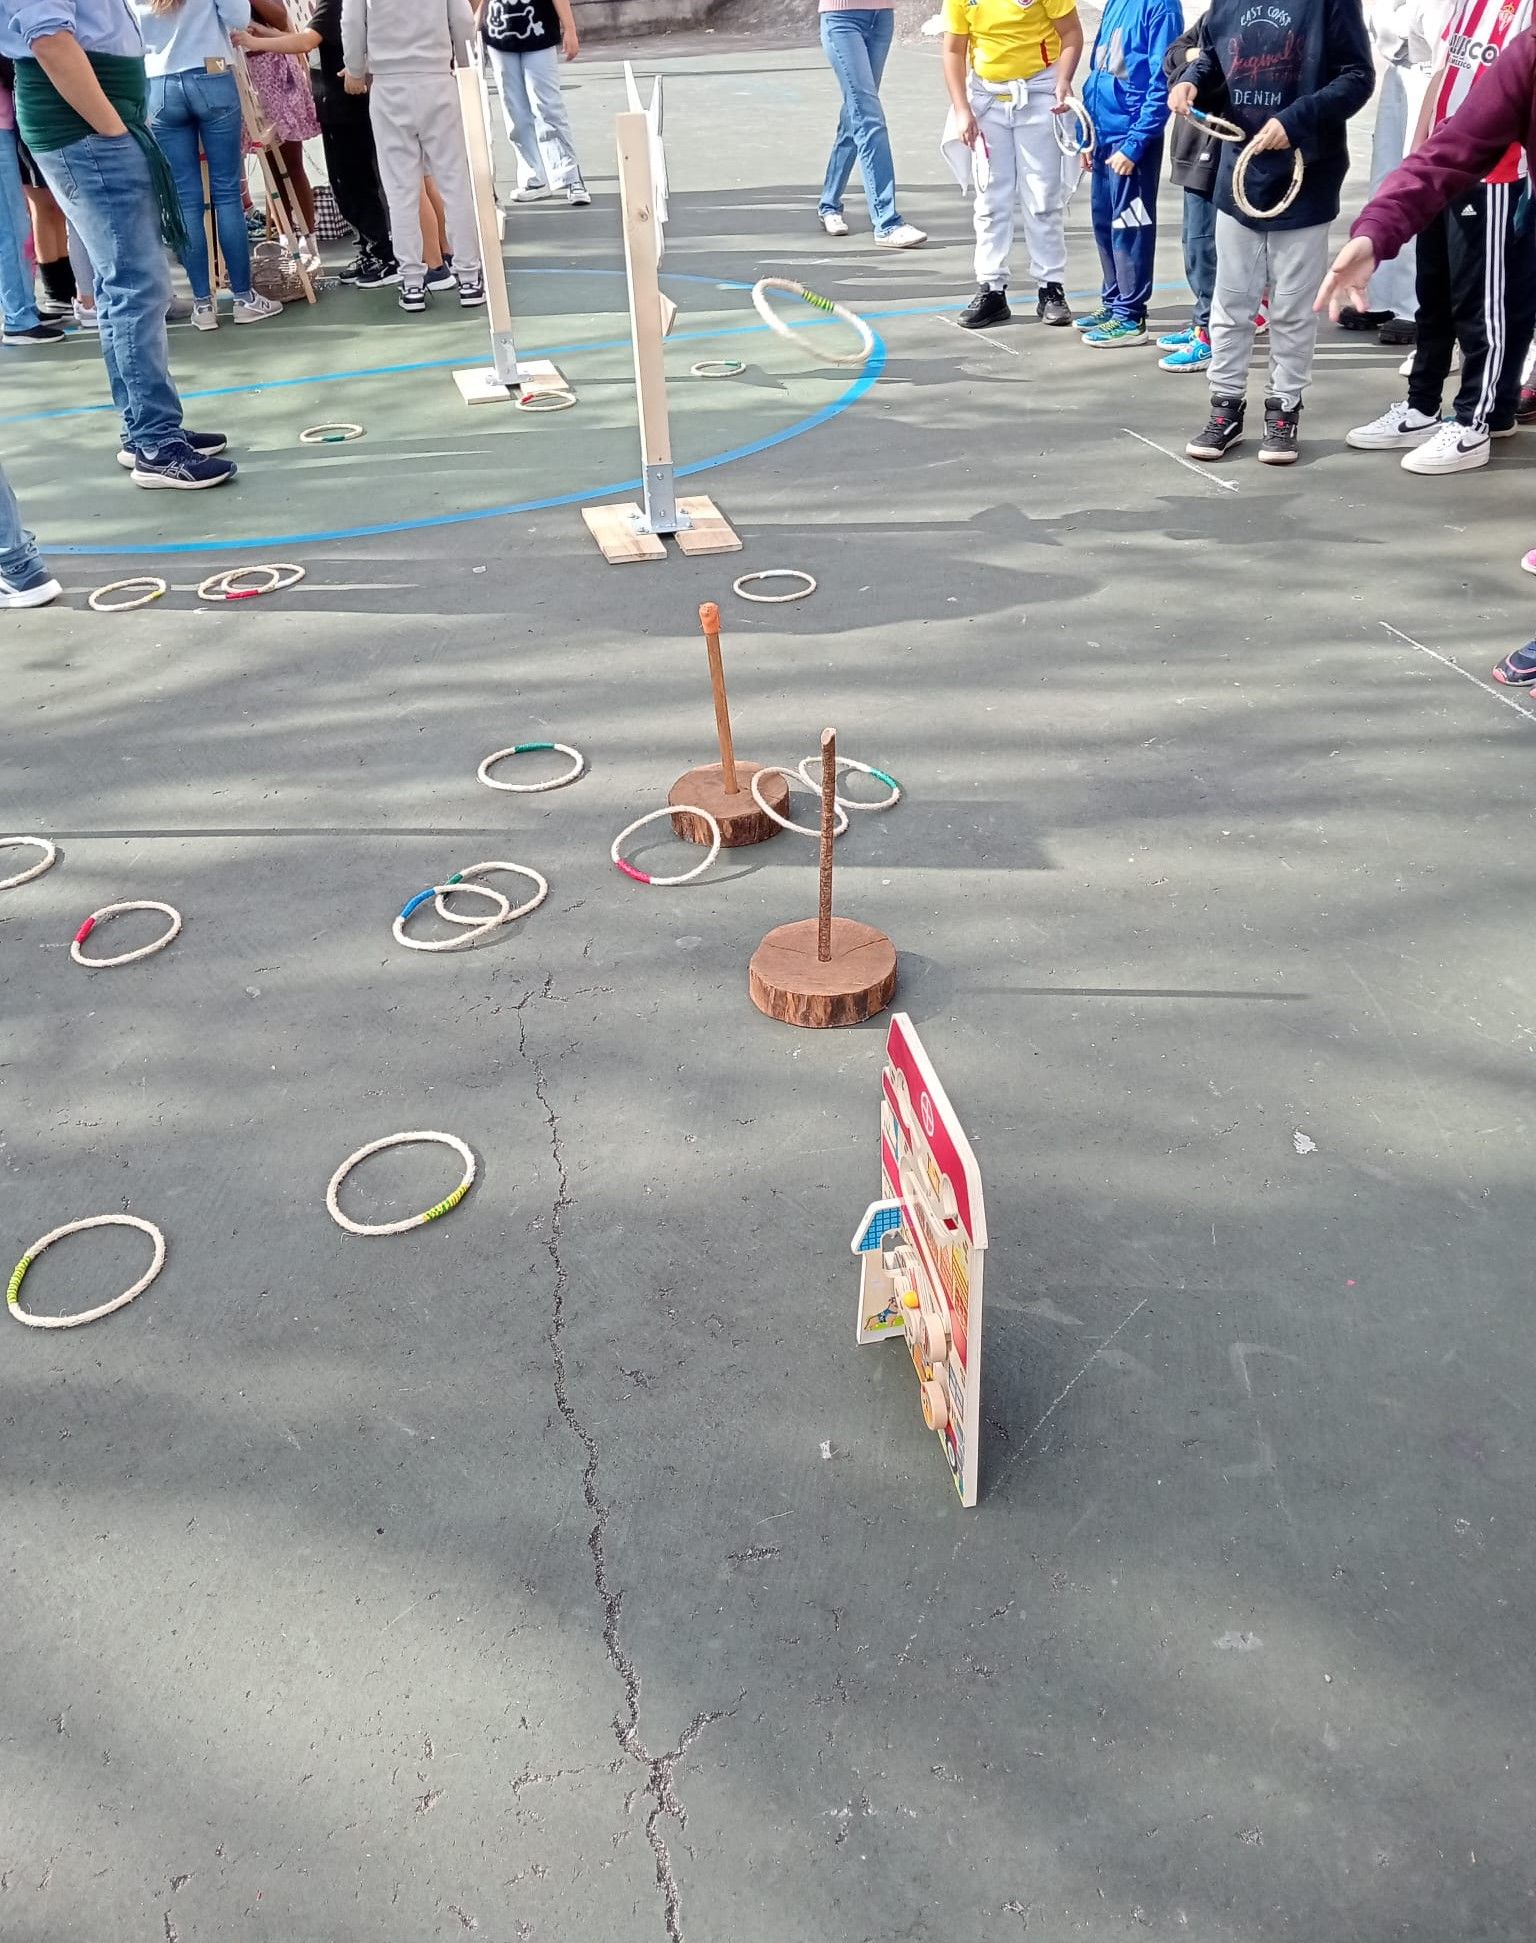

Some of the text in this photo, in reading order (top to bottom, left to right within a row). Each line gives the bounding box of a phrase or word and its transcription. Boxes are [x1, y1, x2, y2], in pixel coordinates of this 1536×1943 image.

[1240, 5, 1291, 26] EAST COAST
[1232, 89, 1282, 106] DENIM
